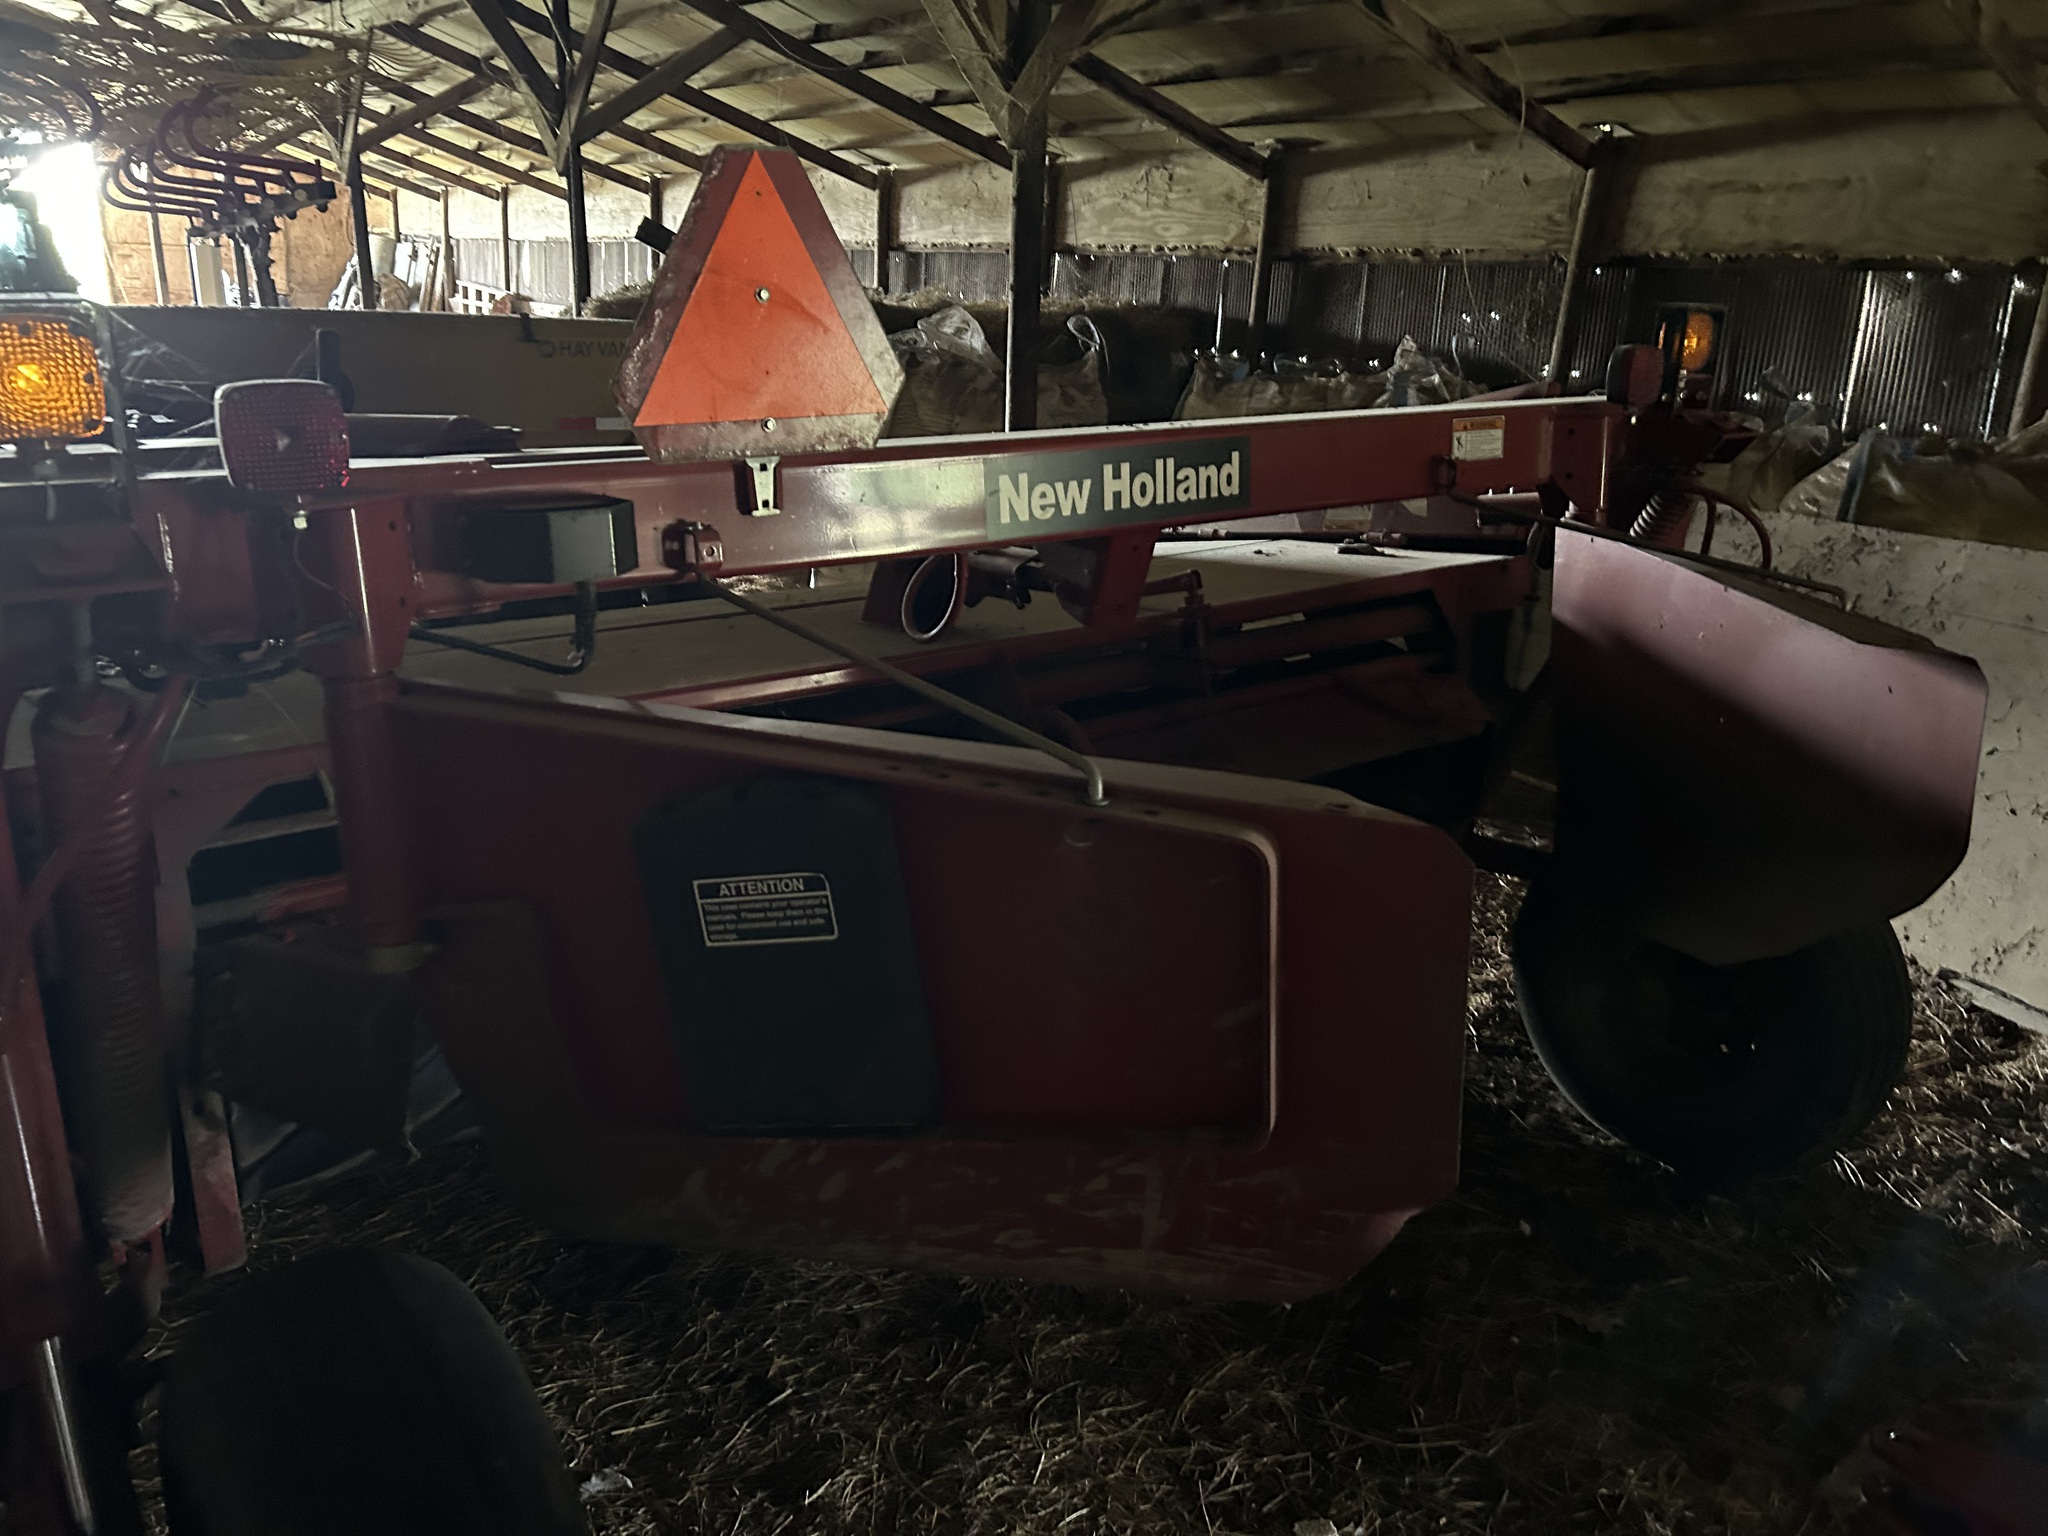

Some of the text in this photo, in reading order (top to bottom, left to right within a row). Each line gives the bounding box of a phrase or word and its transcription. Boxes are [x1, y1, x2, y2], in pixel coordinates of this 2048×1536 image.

[560, 340, 593, 358] HAY
[999, 450, 1240, 524] New Holland
[719, 877, 805, 897] ATTENTION
